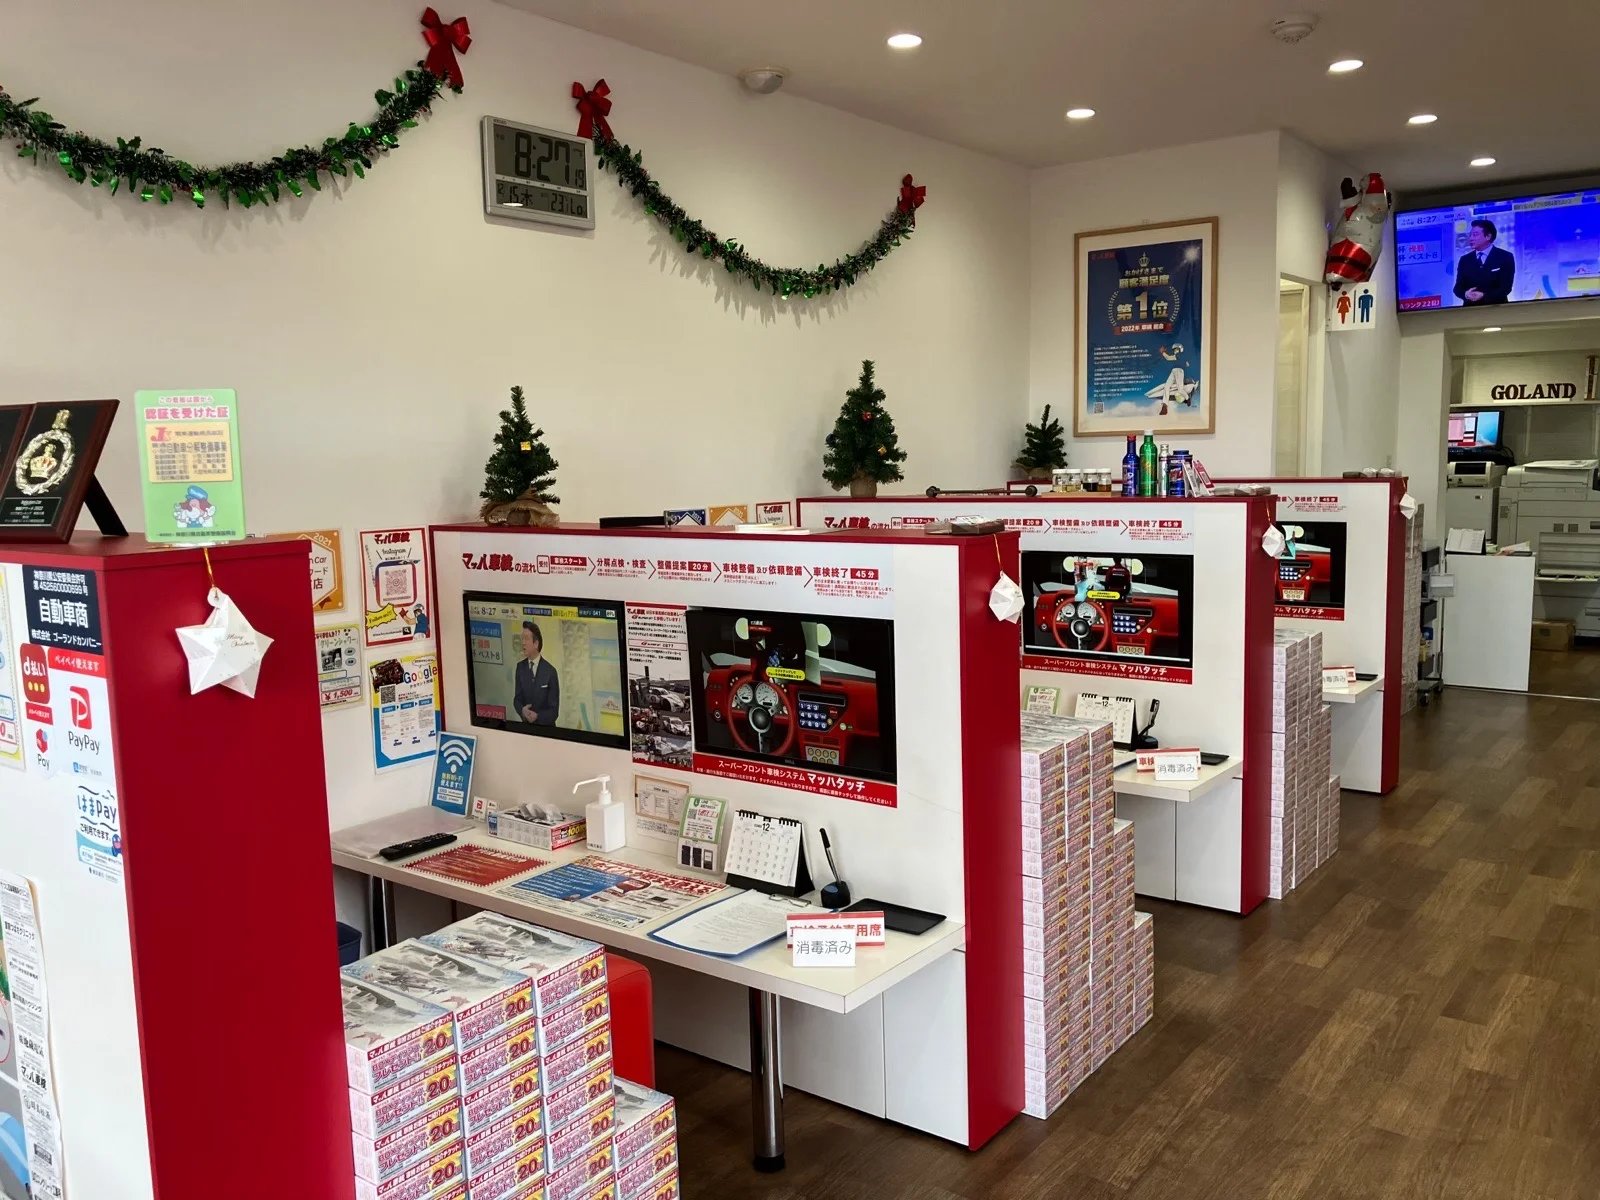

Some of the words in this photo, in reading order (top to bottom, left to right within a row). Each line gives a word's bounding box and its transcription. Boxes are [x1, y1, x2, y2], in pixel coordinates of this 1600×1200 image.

[515, 131, 570, 184] 8:27
[1409, 252, 1438, 261] ベスト8
[1119, 274, 1170, 289] 顧客満足度
[1117, 290, 1169, 321] 第1位
[1491, 383, 1577, 401] GOLAND
[145, 407, 229, 420] 認証を受けた証
[1128, 520, 1158, 528] 車検終了
[313, 532, 332, 547] 2021
[597, 558, 647, 569] 分解点検・検査
[657, 559, 688, 570] 整備提案
[692, 563, 709, 571] 20分
[813, 566, 849, 578] 車検終了
[855, 570, 875, 579] 45分
[39, 597, 89, 628] 自動車商
[481, 606, 497, 616] 8:27
[1285, 607, 1325, 615] マッハタッチ
[31, 629, 52, 642] 株式会社
[53, 632, 102, 648] ゴーランドカンパニー
[23, 656, 46, 676] d払い
[55, 655, 100, 672] ペイペイ使えます
[1119, 664, 1168, 676] マッハタッチ
[403, 664, 438, 684] Google
[68, 731, 100, 756] PayPay
[37, 753, 50, 772] Pay
[1157, 764, 1195, 774] 消毒済み
[718, 760, 806, 782] スーパーフロント車検システム
[807, 772, 866, 792] マッハタッチ
[77, 794, 117, 824] はまPay
[762, 822, 771, 832] 12
[796, 940, 853, 955] 消毒済み
[20, 1065, 47, 1092] マッハ車検
